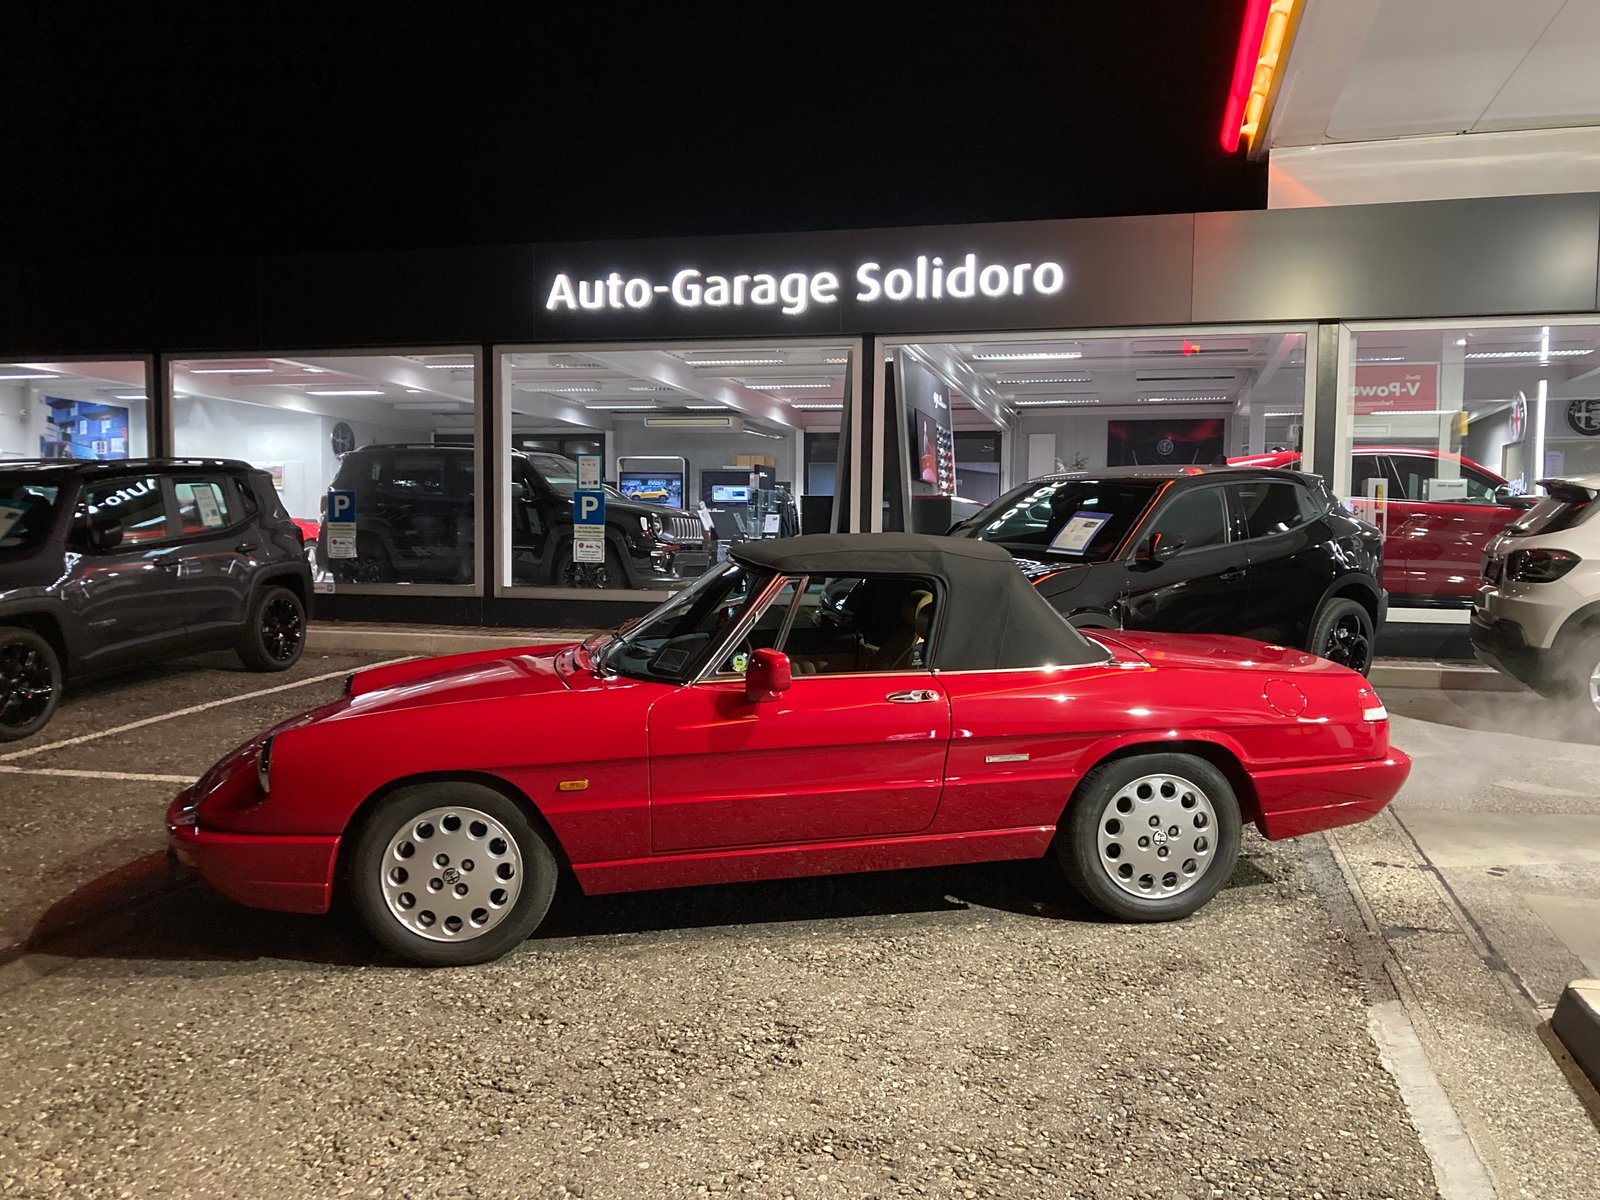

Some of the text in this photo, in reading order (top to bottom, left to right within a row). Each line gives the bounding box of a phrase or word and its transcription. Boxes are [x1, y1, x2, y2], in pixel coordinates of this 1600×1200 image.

[545, 252, 1066, 316] Auto-Garage Solidoro
[334, 494, 351, 518] P
[581, 495, 599, 520] P
